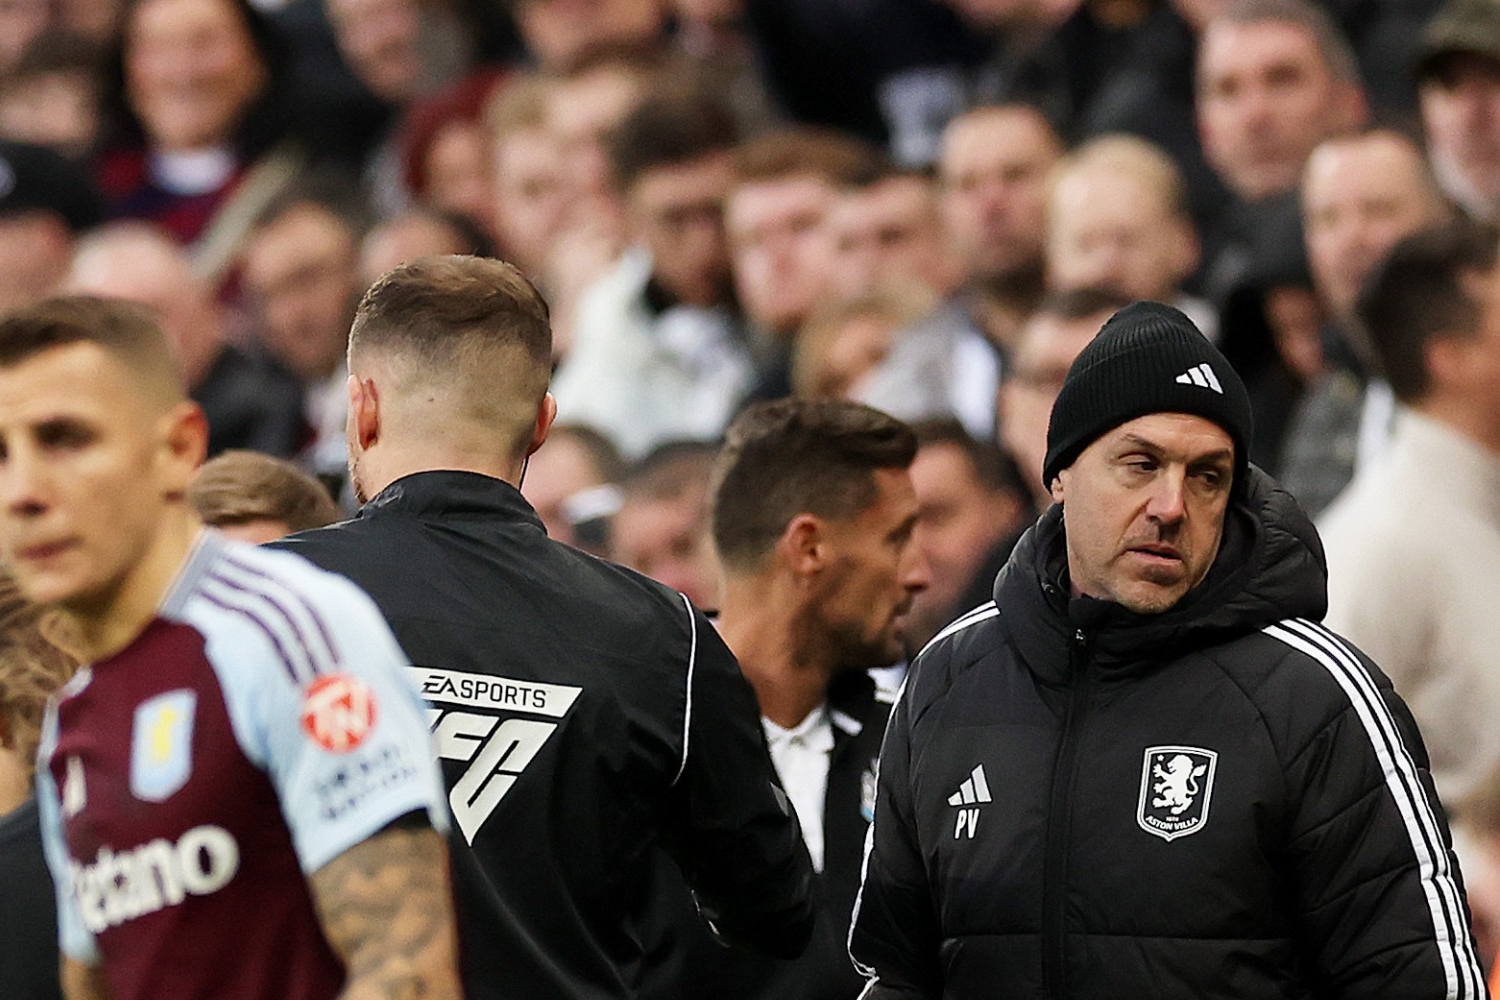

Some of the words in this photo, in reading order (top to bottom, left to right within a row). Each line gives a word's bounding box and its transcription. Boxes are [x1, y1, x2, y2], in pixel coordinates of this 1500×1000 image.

[421, 675, 458, 697] EA
[460, 679, 546, 708] SPORTS
[954, 808, 980, 839] PV
[1145, 815, 1173, 830] ASTON
[1174, 816, 1198, 830] VILLA
